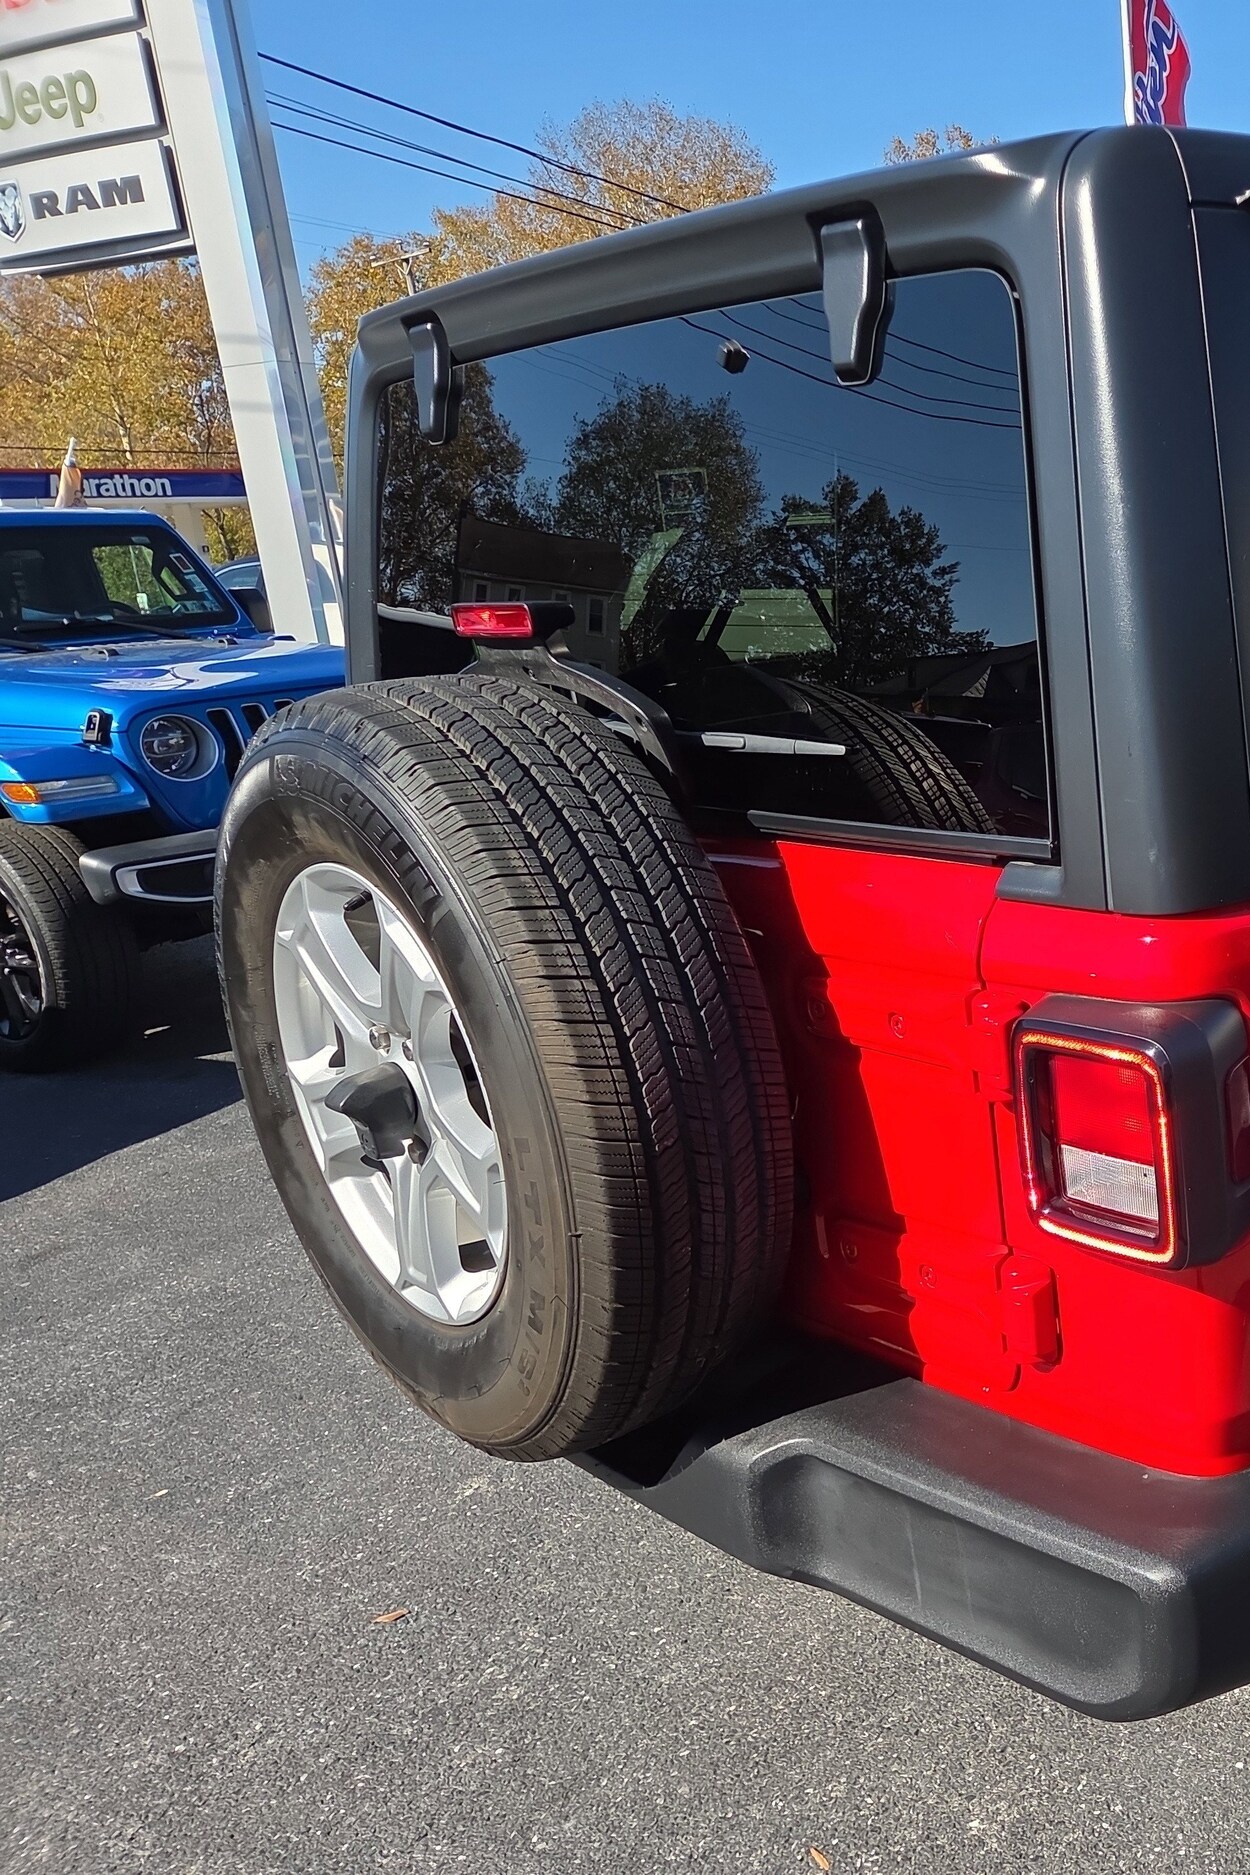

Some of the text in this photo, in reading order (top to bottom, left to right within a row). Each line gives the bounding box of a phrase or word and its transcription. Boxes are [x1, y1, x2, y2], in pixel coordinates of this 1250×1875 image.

[0, 69, 97, 129] Jeep
[29, 174, 146, 221] RAM
[301, 760, 438, 908] MICHELIN
[513, 1136, 546, 1269] LTX
